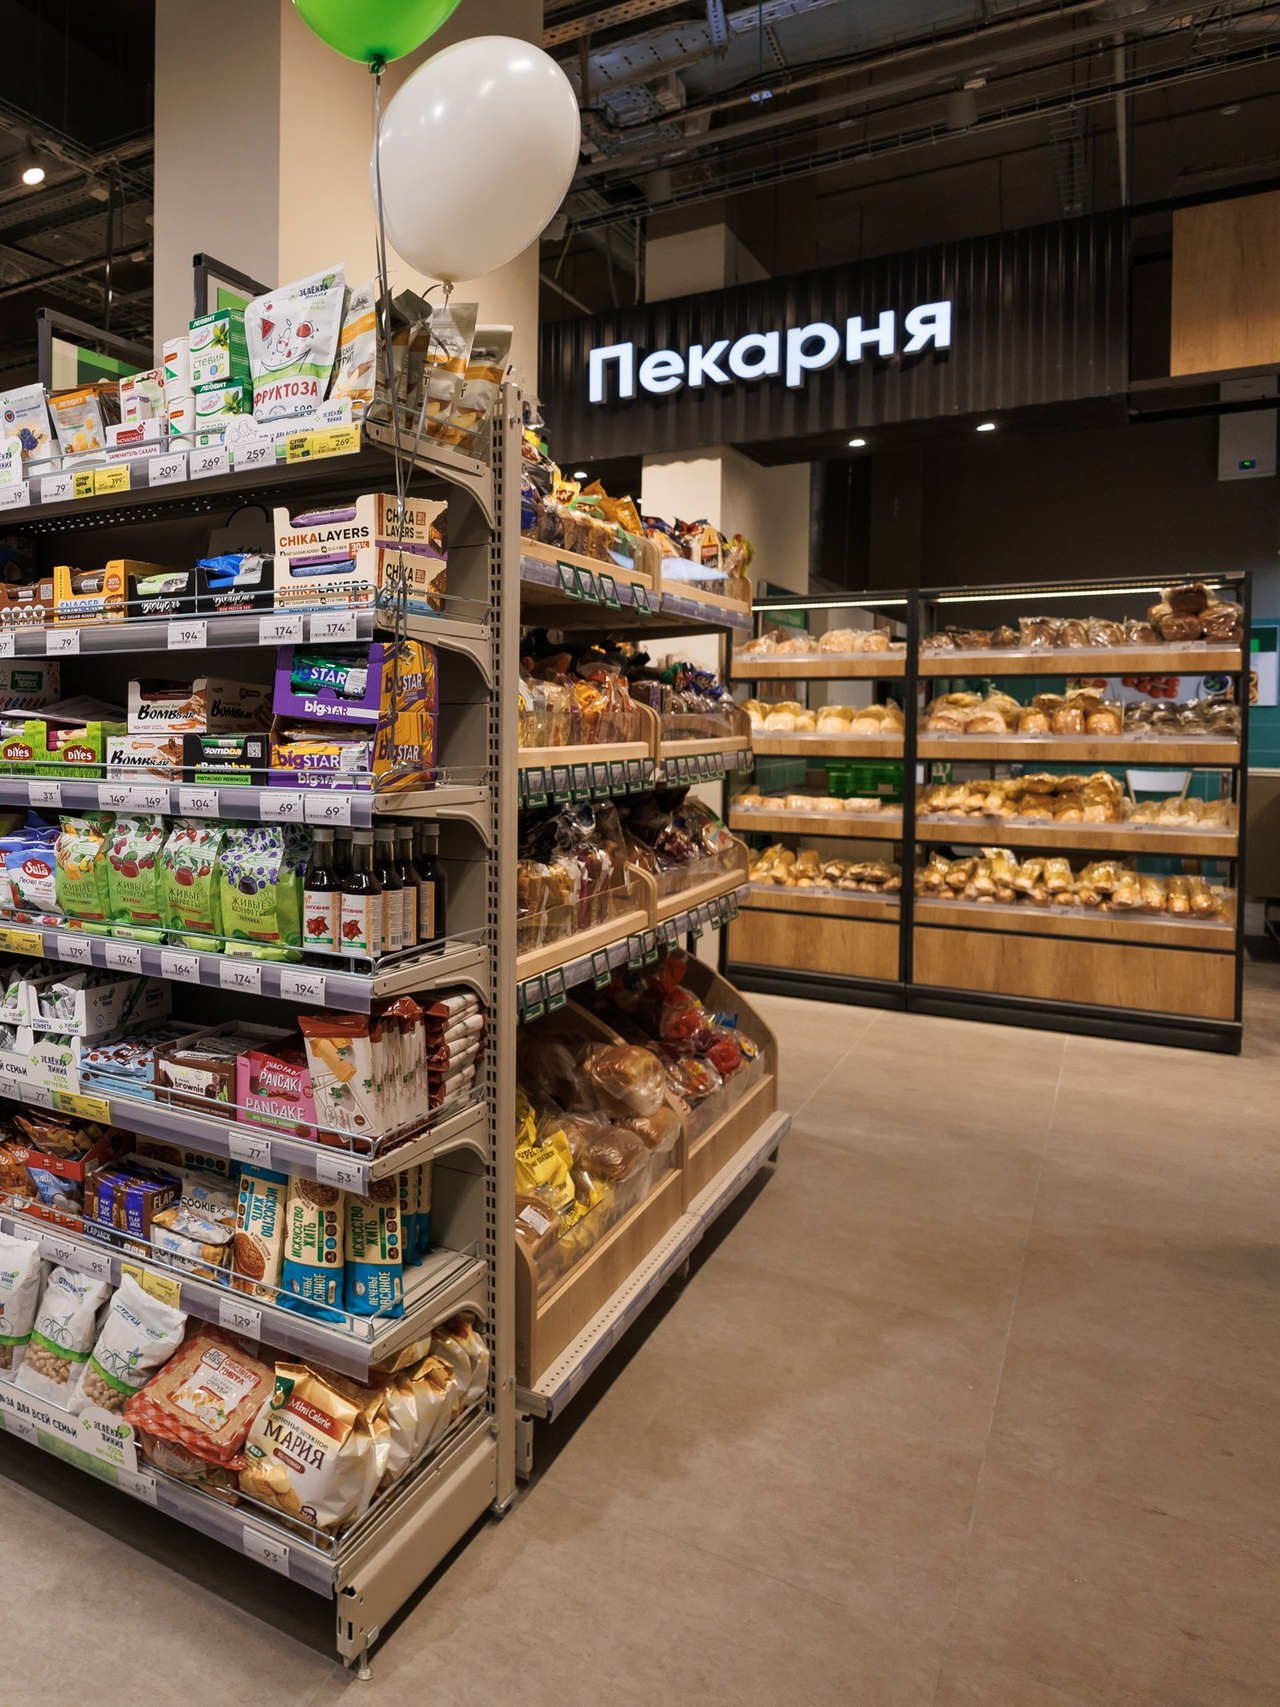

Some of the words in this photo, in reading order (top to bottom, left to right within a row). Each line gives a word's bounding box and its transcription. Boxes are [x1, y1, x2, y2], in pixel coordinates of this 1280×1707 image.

[193, 315, 216, 327] ЛЕОВИТ
[589, 301, 952, 404] Пекарня
[200, 381, 227, 392] ЛЕОВИТ
[254, 381, 318, 406] ФРУКТОЗА
[58, 397, 83, 409] ЛЕОВИТ
[289, 437, 307, 445] СУПЕР
[289, 443, 305, 451] ЦЕНА
[335, 438, 350, 447] 269
[109, 450, 138, 461] ЗАМЕНИТЕЛЬ
[138, 447, 158, 456] САХАРА
[246, 449, 266, 460] 259
[202, 457, 220, 468] 269
[159, 465, 178, 476] 209
[56, 484, 66, 493] 79
[386, 508, 414, 525] CHKA
[279, 526, 369, 548] CHIKALAYERS
[386, 563, 413, 582] CHKA
[1, 604, 46, 621] COCO
[59, 600, 100, 613] SNAQER
[275, 626, 293, 636] 174
[327, 623, 345, 633] 174
[181, 631, 197, 641] 194
[62, 639, 72, 647] 79
[385, 673, 424, 697] bgSTAR
[277, 750, 341, 769] bigSTAR
[43, 792, 53, 800] 33
[110, 795, 125, 804] 149
[145, 797, 161, 806] 149
[191, 799, 209, 808] 104
[279, 803, 293, 812] 69
[325, 806, 340, 815] 69
[25, 861, 49, 876] Sulá
[62, 882, 91, 892] ЖИВЫЕ
[116, 881, 146, 892] ЖИВЫЕ
[169, 887, 200, 901] ЖИВЫЕ
[232, 897, 266, 910] ЖИВЫЕ
[232, 906, 266, 917] КОНФЕТЫ
[69, 948, 83, 956] 179
[118, 955, 132, 964] 174
[174, 964, 190, 974] 164
[234, 974, 251, 984] 174
[295, 983, 314, 995] 194
[40, 1055, 67, 1067] ЗЕЛЁНАЯ
[266, 1061, 283, 1070] SNAQ
[6, 1063, 27, 1076] СЕМЬИ
[48, 1065, 67, 1076] ЛИНИЯ
[53, 1074, 67, 1084] 100%
[174, 1077, 204, 1094] brownie
[35, 1091, 44, 1100] 77
[246, 1097, 306, 1121] PANCAKE
[261, 1117, 277, 1125] SUGAR
[278, 1121, 296, 1129] ADDED
[248, 1148, 261, 1157] 77
[337, 1172, 352, 1182] 53
[153, 1191, 174, 1208] FLAP
[181, 1197, 216, 1213] COOKIE
[251, 1195, 265, 1221] ЖИТЬ
[261, 1187, 279, 1238] ИСКУССТВО
[83, 1225, 111, 1241] FLAPJACK
[291, 1206, 304, 1258] ИСКУССТВО
[303, 1222, 317, 1248] ЖИТЬ
[353, 1206, 364, 1258] ИСКУССТВО
[366, 1220, 378, 1246] ЖИТЬ
[55, 1248, 69, 1259] 109
[92, 1262, 103, 1272] 95
[368, 1275, 378, 1306] ПЕЧЕНЬЕ
[117, 1304, 141, 1327] ОТРУБИ
[233, 1314, 250, 1326] 129
[225, 1359, 258, 1384] ОВСЯНАЯ
[16, 1401, 30, 1416] ДЛЯ
[31, 1407, 51, 1426] ВСЕЙ
[52, 1419, 78, 1439] СЕМЬИ
[93, 1420, 124, 1440] ЗЕЛЁНАЯ
[270, 1413, 300, 1433] печенье
[300, 1428, 329, 1451] затяжное
[101, 1434, 124, 1449] ЛИНИЯ
[263, 1418, 326, 1471] МАРИЯ
[135, 1483, 147, 1493] 63
[262, 1549, 279, 1563] 93
